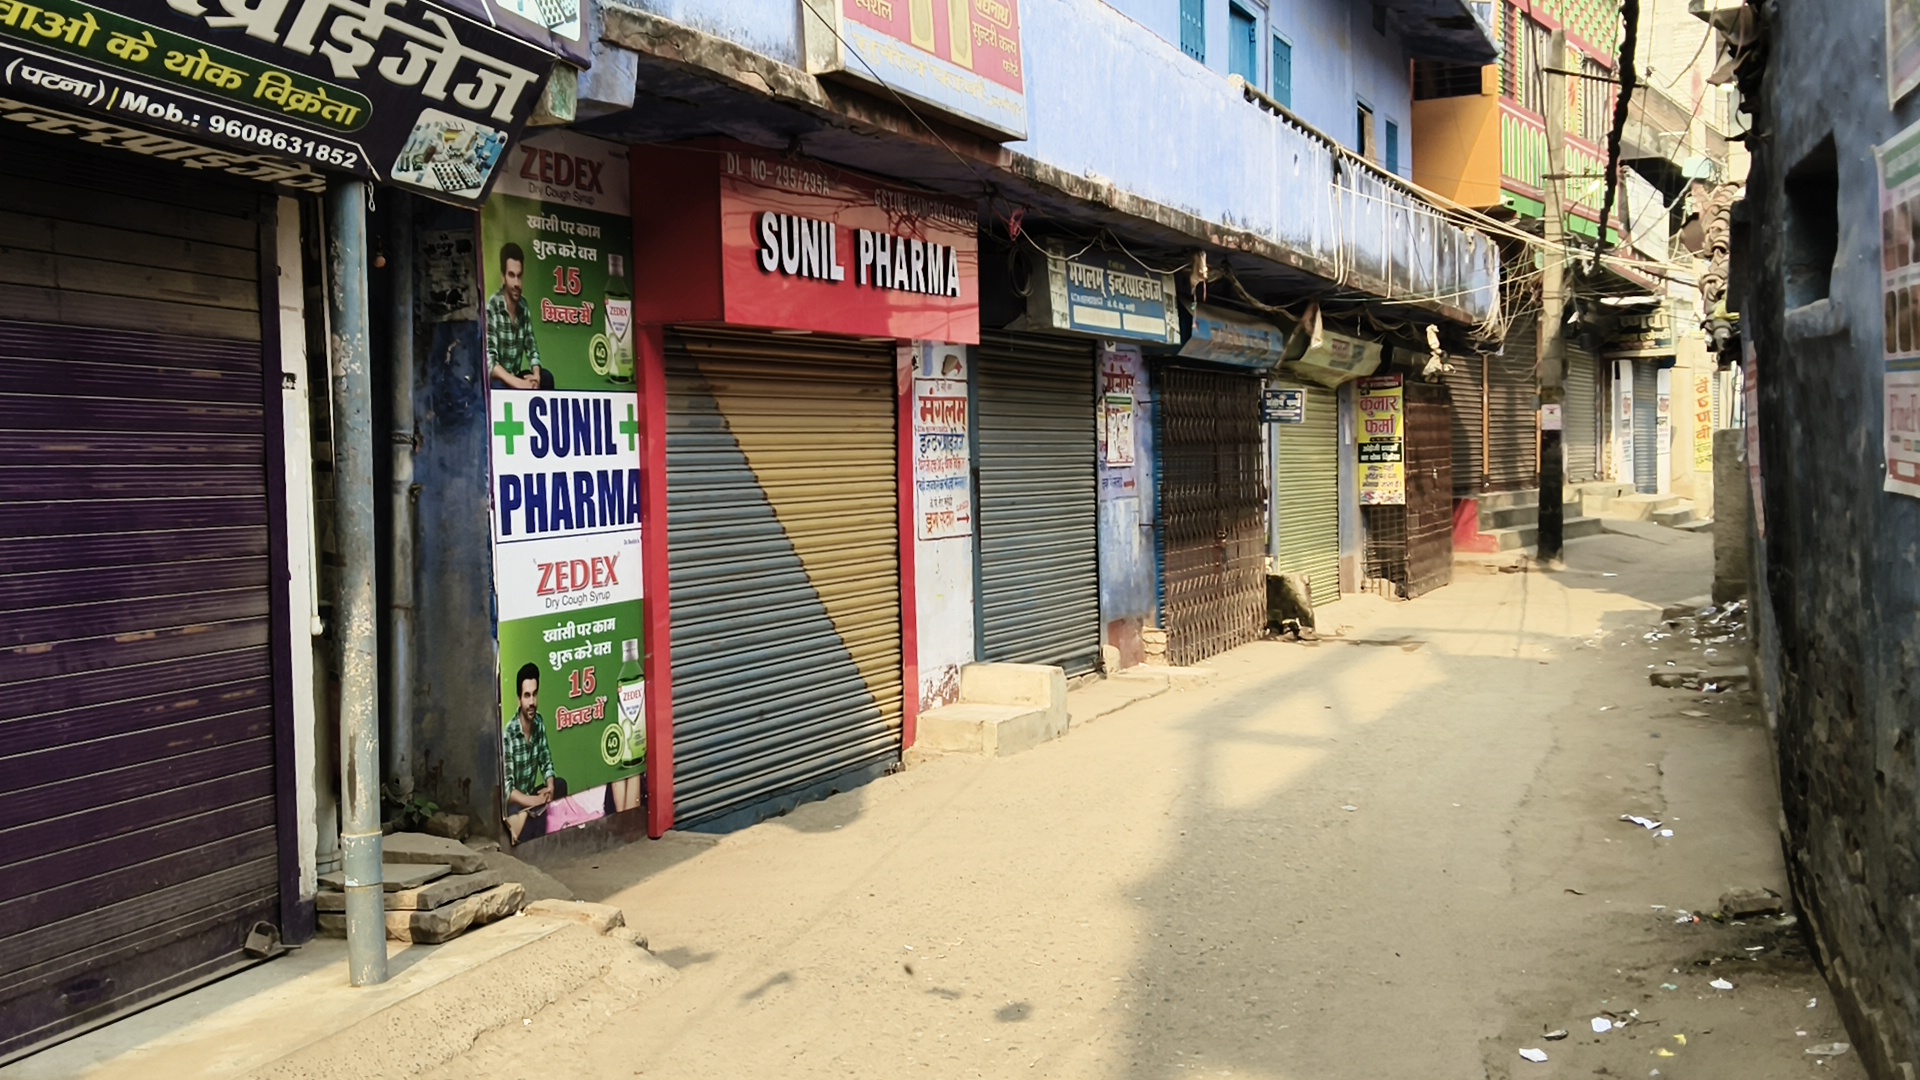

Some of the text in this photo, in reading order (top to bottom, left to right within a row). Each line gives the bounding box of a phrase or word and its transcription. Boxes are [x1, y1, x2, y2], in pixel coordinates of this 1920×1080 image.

[972, 20, 998, 48] सुन्दरी
[106, 30, 157, 63] के
[164, 49, 249, 91] थोक
[253, 70, 361, 126] विक्रेता
[208, 115, 358, 169] 9608631852
[520, 144, 604, 195] ZEDEX
[726, 152, 744, 177] DL
[545, 185, 571, 202] Cough
[526, 212, 601, 239] खांसी पर काम
[577, 245, 598, 261] बस
[760, 210, 962, 298] SUNIL PHARMA
[553, 266, 582, 296] 15
[541, 297, 579, 324] मिनट
[1360, 395, 1400, 418] कुमार
[528, 396, 618, 459] SUNIL
[498, 468, 642, 537] PHARMA
[536, 554, 620, 597] ZEDEX
[544, 589, 611, 610] Dry Cough Syrup
[542, 617, 616, 643] खांसी पर काम
[593, 641, 612, 656] बस
[568, 666, 597, 698] 15
[622, 688, 642, 702] ZEDEX
[556, 704, 593, 732] मिनट
